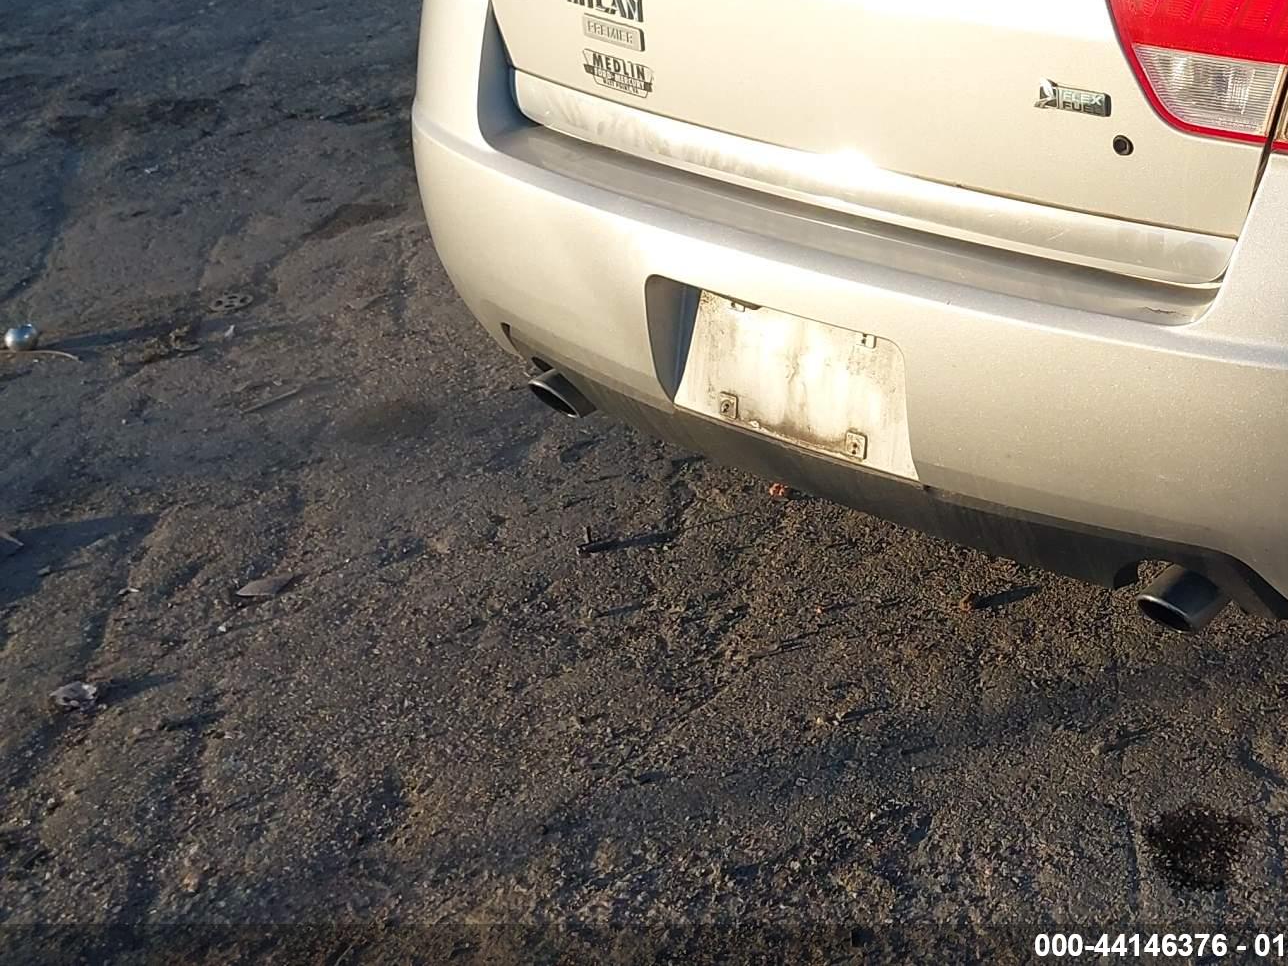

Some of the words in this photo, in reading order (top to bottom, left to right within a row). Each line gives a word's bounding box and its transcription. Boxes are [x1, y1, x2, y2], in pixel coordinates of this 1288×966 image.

[592, 52, 646, 81] MEDLIN
[1062, 90, 1103, 106] FLEX
[1062, 100, 1103, 116] FUEL
